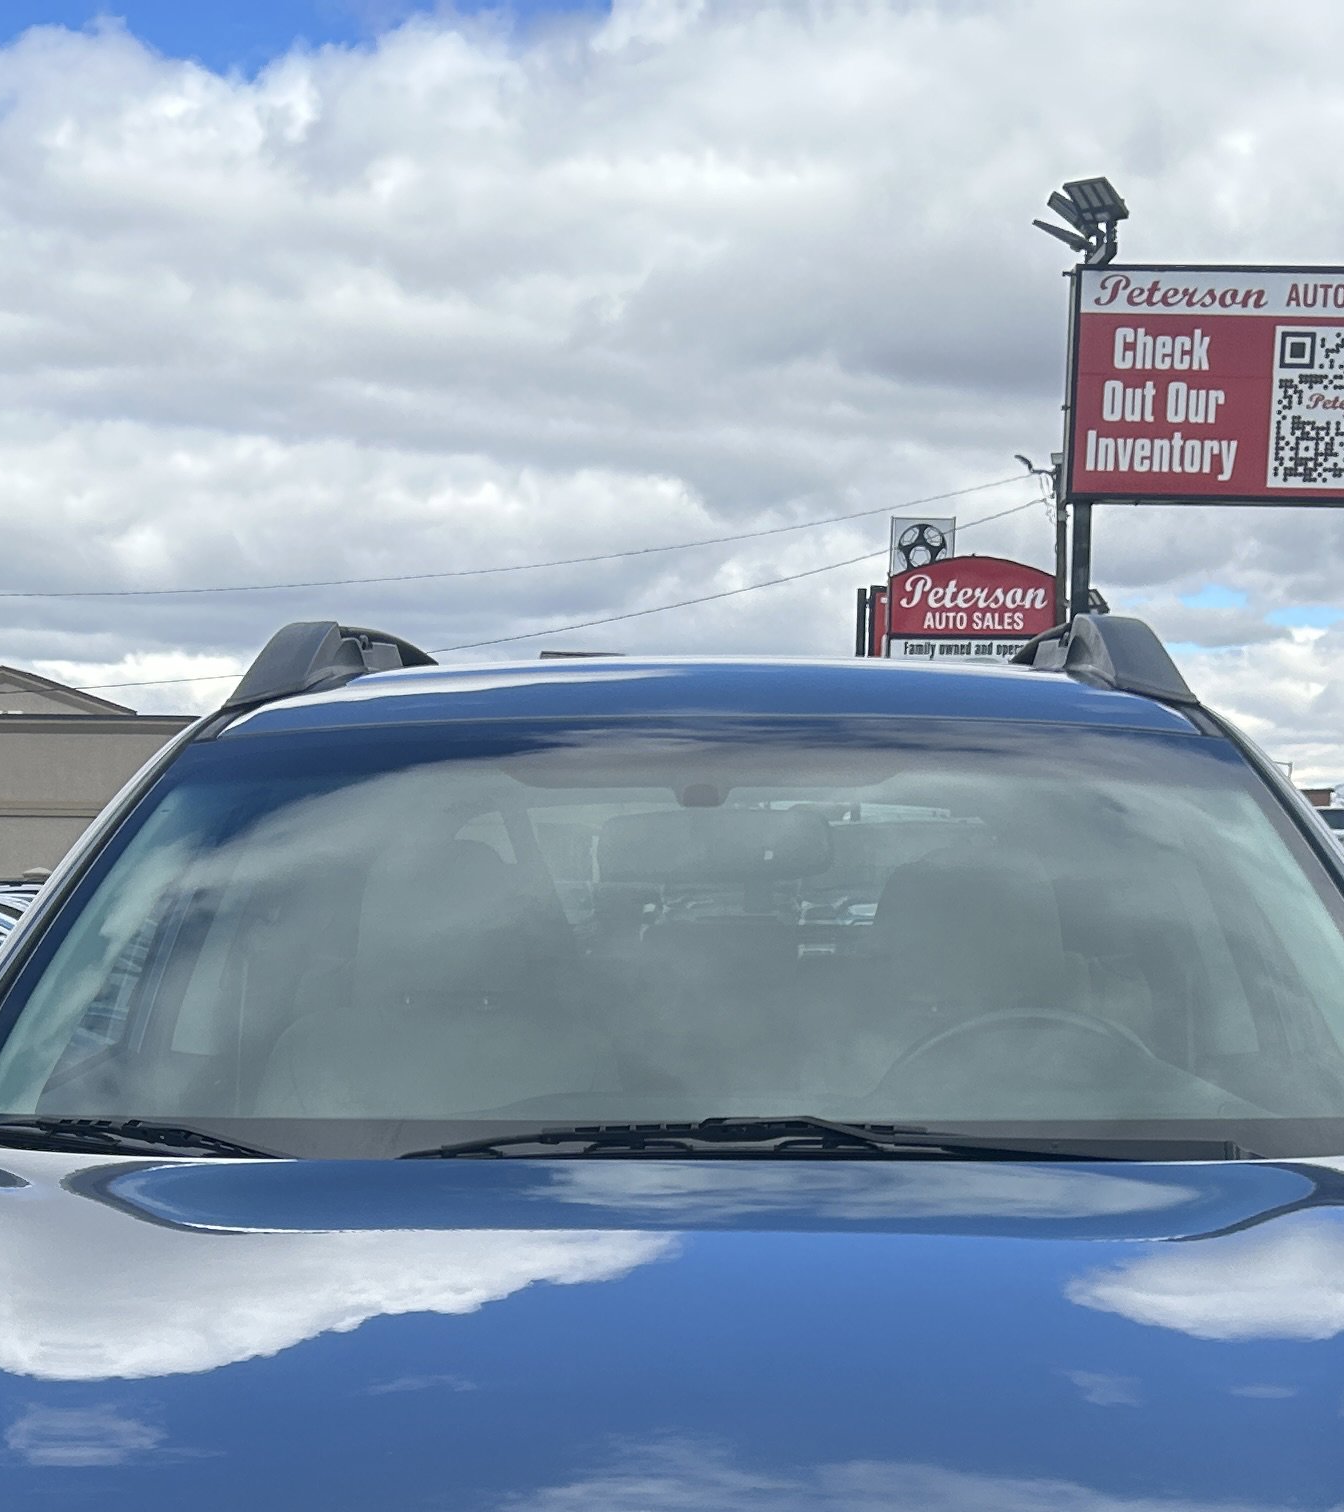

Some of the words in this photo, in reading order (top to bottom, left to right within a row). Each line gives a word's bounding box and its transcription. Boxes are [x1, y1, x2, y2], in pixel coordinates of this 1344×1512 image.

[1094, 273, 1268, 309] Peterson
[1113, 327, 1211, 371] Check
[1102, 380, 1155, 422] Out
[1166, 382, 1225, 424] Our
[1085, 430, 1238, 481] Inventory
[900, 574, 1048, 610] Peterson
[923, 611, 966, 630] AUTO
[972, 612, 1024, 630] SALES
[904, 641, 936, 660] Family
[939, 641, 972, 655] owned
[974, 642, 993, 655] and
